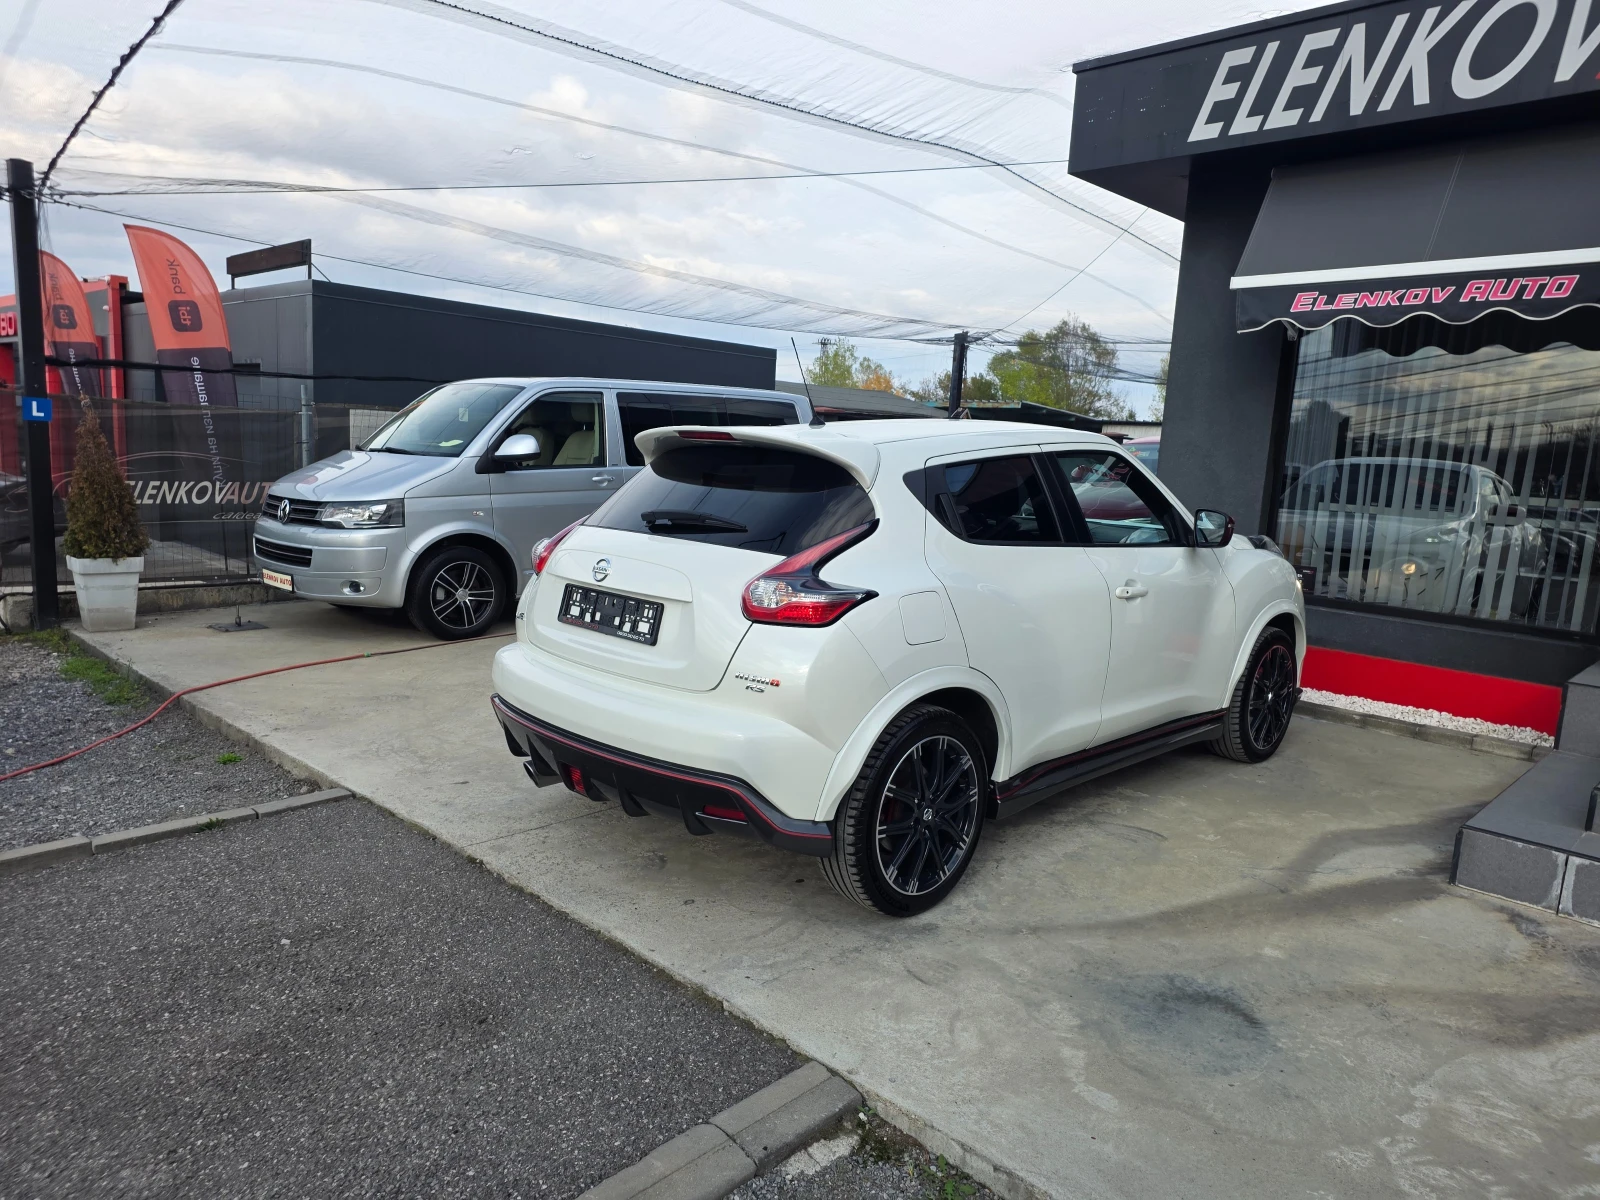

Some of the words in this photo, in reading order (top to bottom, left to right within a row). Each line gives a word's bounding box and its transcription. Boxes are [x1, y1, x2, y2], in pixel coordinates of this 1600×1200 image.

[1187, 0, 1600, 143] ELENKOV
[1290, 286, 1456, 312] ELENKOV
[1459, 274, 1580, 302] AUTO
[32, 400, 45, 416] L
